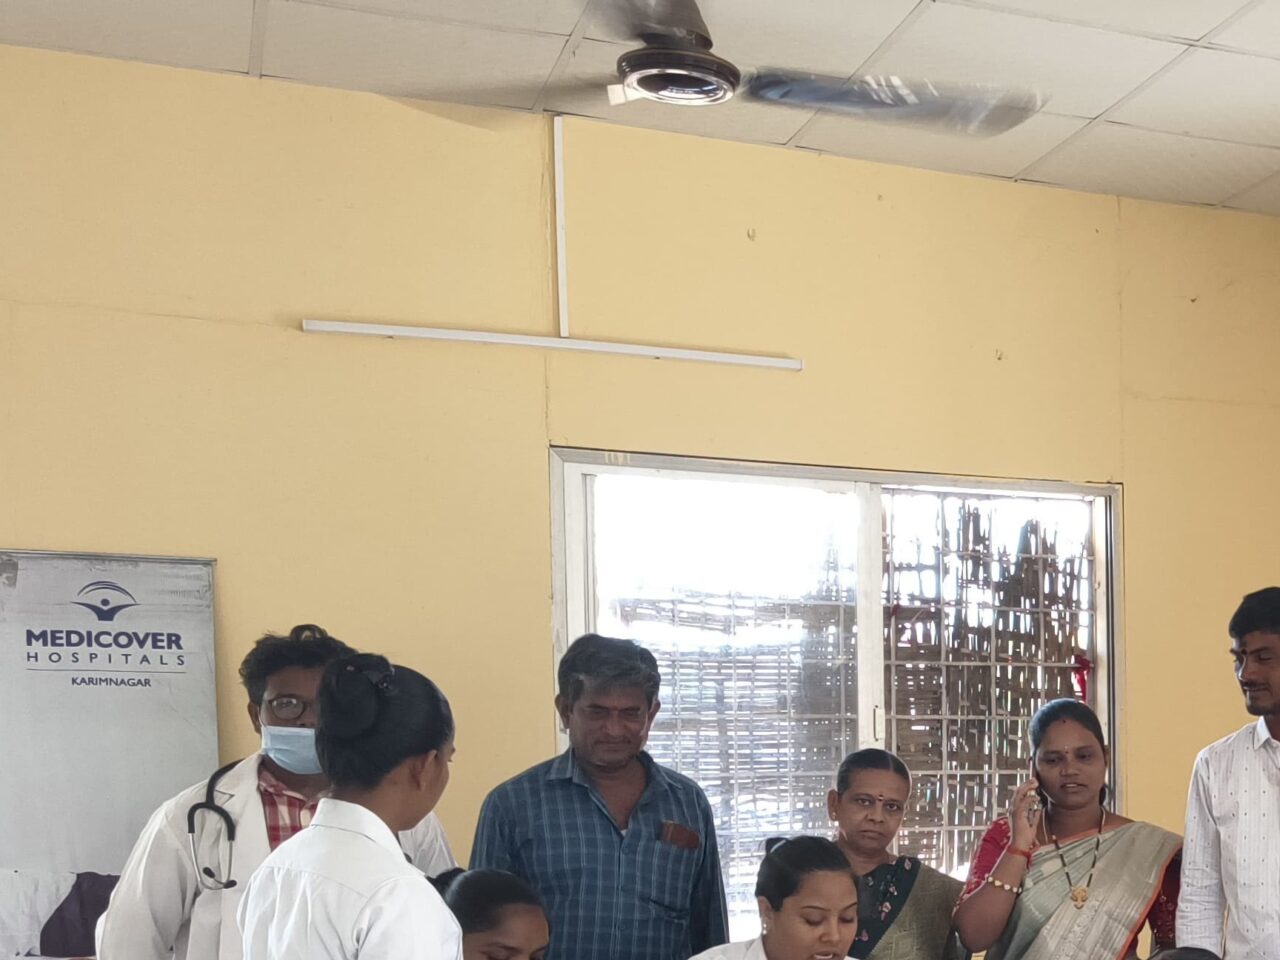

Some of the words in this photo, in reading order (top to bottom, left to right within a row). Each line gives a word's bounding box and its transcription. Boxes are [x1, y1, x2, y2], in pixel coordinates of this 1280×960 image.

[25, 629, 184, 650] MEDICOVER
[26, 651, 186, 666] HOSPITALS
[71, 676, 152, 688] KARIMNAGAR
